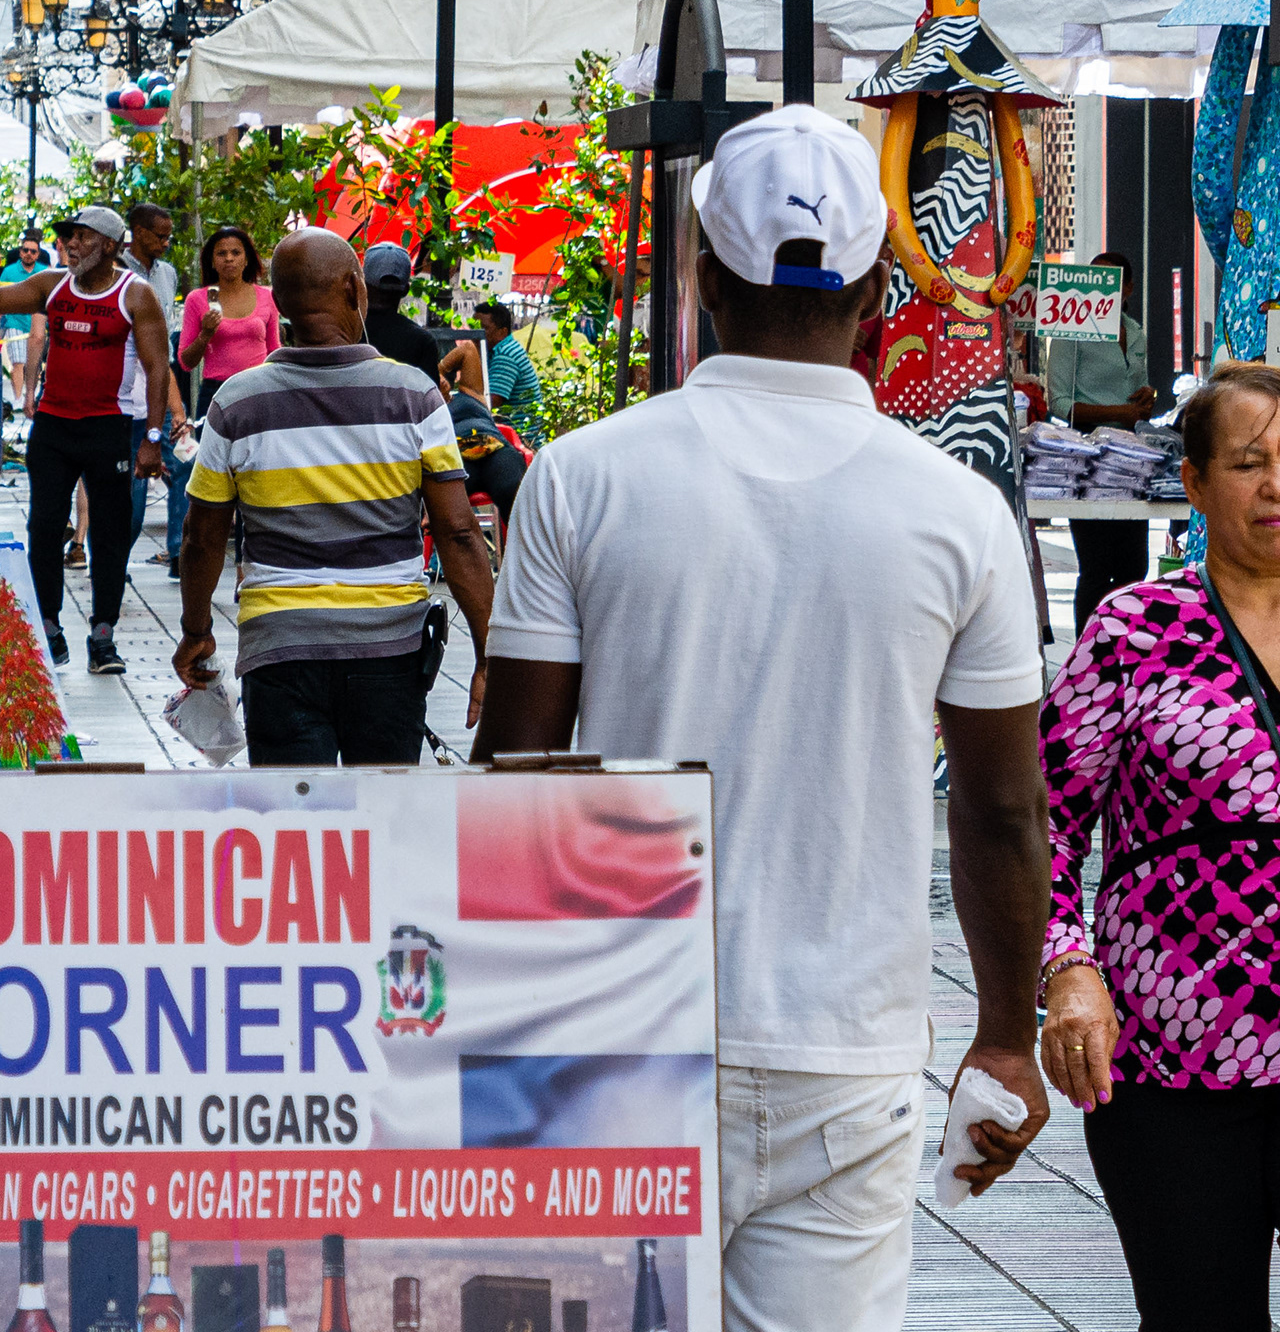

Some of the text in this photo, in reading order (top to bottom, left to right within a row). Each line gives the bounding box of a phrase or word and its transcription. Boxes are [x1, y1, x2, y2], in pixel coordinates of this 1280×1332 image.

[1047, 268, 1115, 285] Blumin's
[84, 303, 117, 319] YORK
[1043, 330, 1109, 340] ESPECIAL
[199, 1093, 359, 1146] CIGARS
[31, 1171, 137, 1222] CIGARS
[168, 1169, 363, 1219] CIGARETTERS
[393, 1168, 517, 1220] LIQUORS
[546, 1168, 604, 1217] AND
[613, 1166, 691, 1216] MORE
